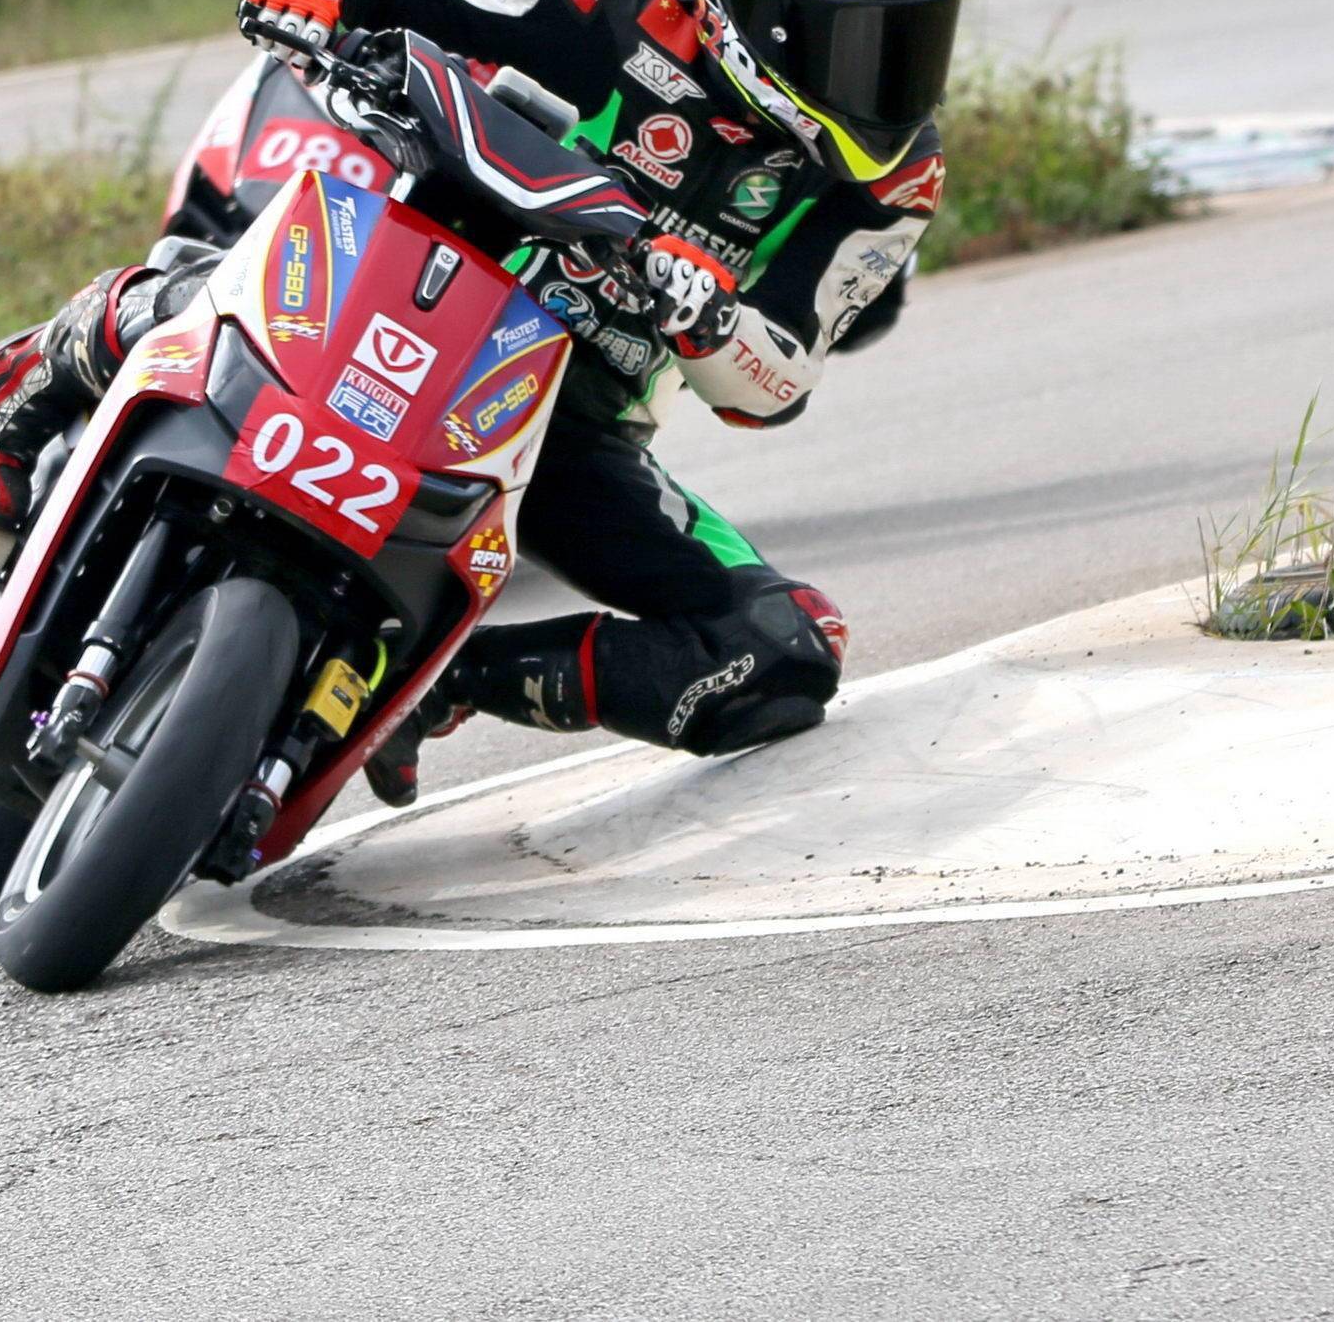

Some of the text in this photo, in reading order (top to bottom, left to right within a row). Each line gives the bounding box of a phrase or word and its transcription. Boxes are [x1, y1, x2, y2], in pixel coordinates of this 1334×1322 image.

[630, 42, 705, 99] KYT
[258, 129, 375, 189] 089
[345, 368, 406, 413] KNIGHT
[730, 338, 797, 402] TAILG
[252, 413, 400, 534] 022
[471, 549, 507, 568] RPM
